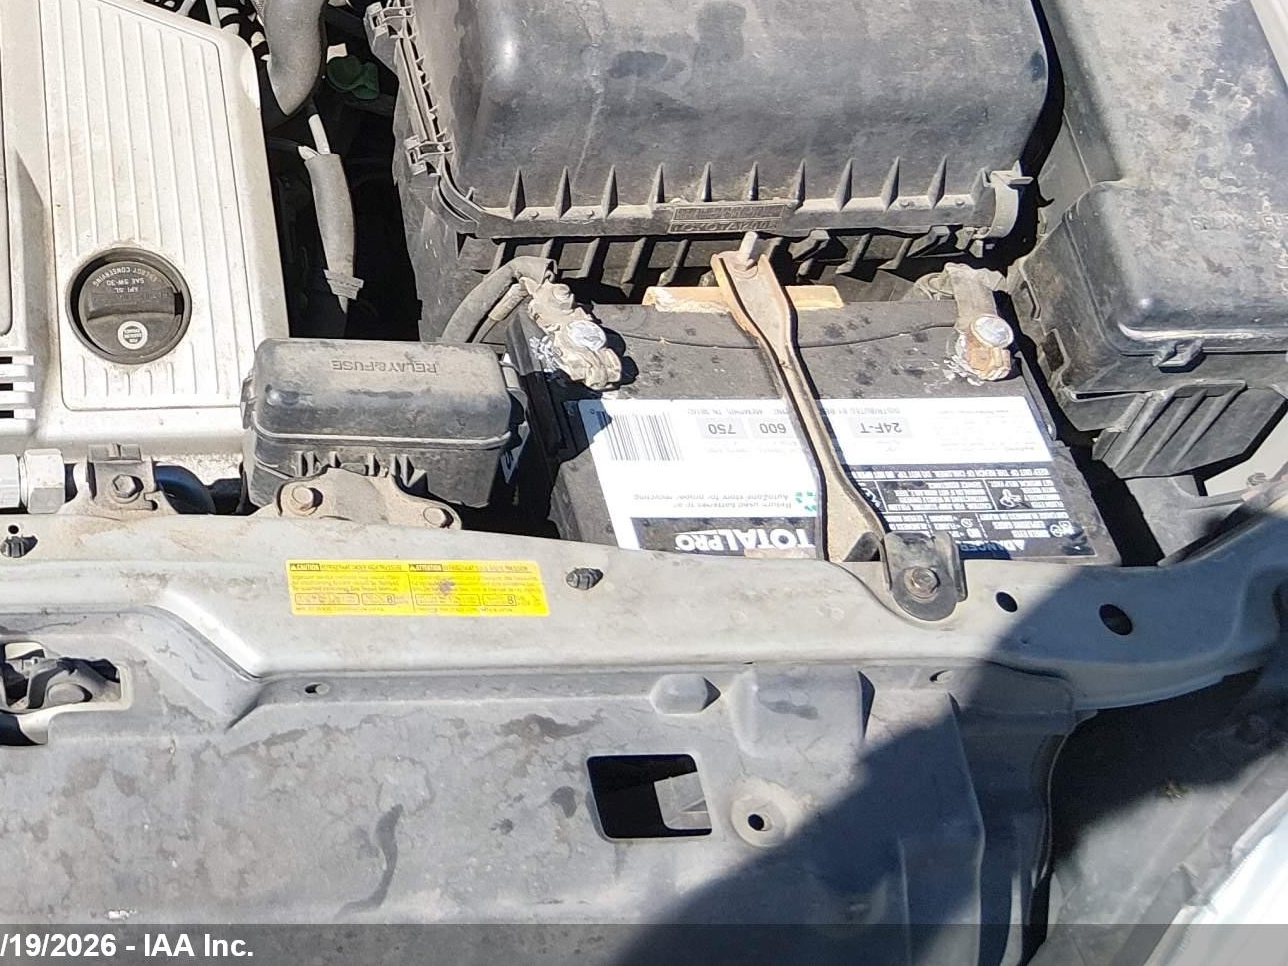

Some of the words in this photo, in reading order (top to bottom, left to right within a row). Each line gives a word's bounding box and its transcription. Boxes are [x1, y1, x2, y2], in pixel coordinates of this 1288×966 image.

[93, 266, 131, 287] CONSERVING
[106, 278, 129, 286] 5W-30
[331, 359, 439, 373] RELAY&FUSE
[707, 423, 737, 435] 750
[759, 423, 787, 434] 600
[858, 422, 903, 434] 24F-T
[747, 493, 789, 502] AutoZone
[674, 528, 816, 551] TOTALPRO
[955, 539, 1017, 552] DANGER
